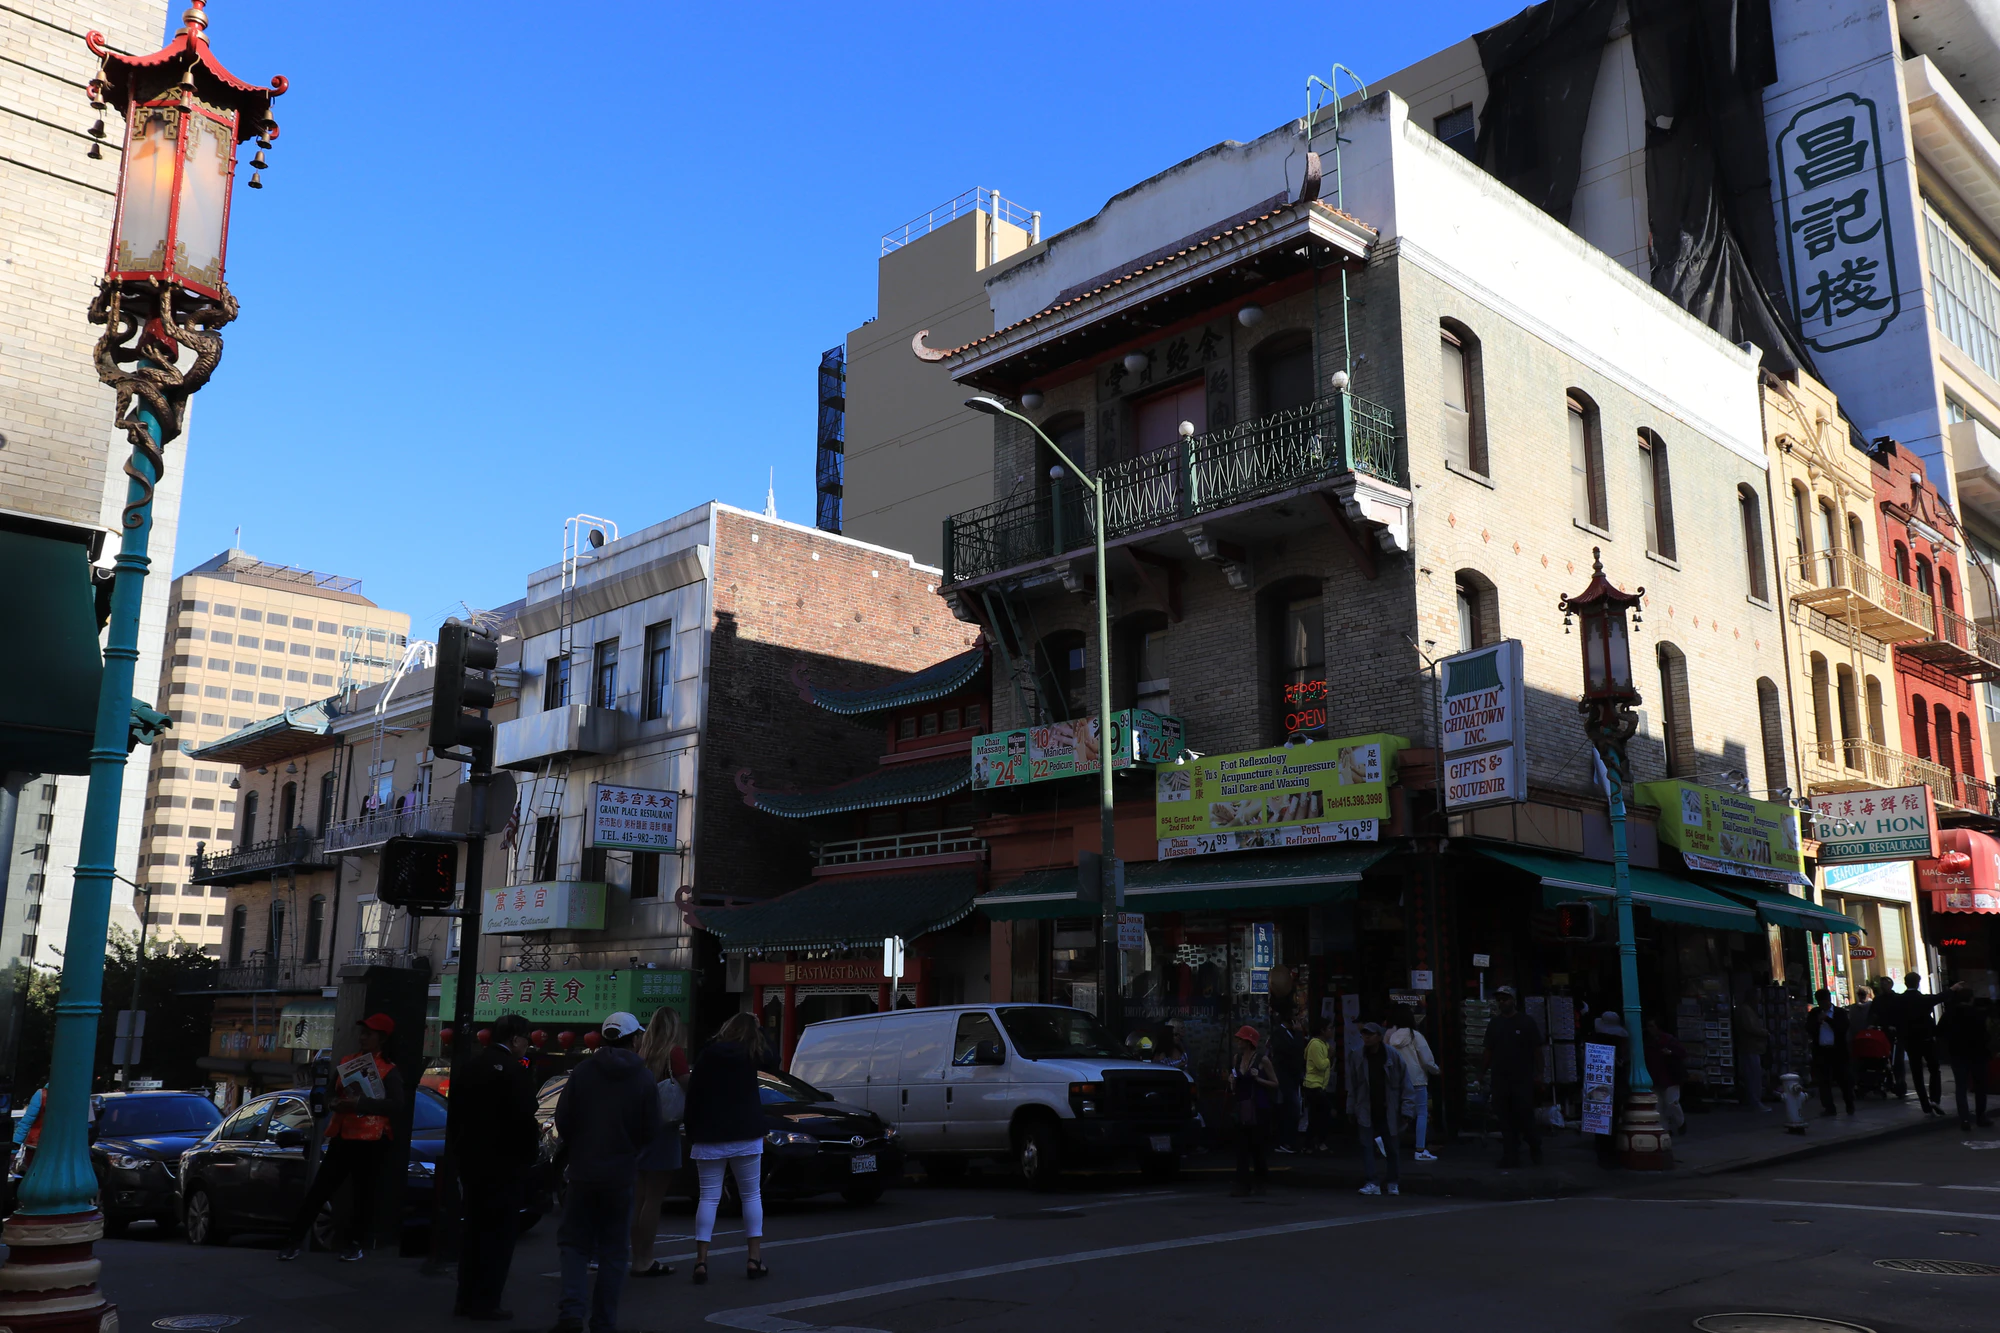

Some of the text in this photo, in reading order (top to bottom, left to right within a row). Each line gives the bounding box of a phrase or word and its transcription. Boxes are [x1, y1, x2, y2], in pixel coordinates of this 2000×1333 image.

[1449, 690, 1499, 716] ONLY IN
[1135, 719, 1160, 732] Massage
[1285, 707, 1327, 731] OPEN
[1444, 707, 1505, 734] CHINATOWN
[984, 737, 1000, 747] Chair
[1464, 729, 1487, 746] INC.
[977, 745, 1006, 755] Massage
[1043, 745, 1073, 757] Manicure
[1050, 760, 1073, 771] Pedicure
[1075, 762, 1091, 772] Foot
[1221, 754, 1287, 770] Foot Reflexology
[1450, 755, 1502, 779] GIFTS &
[1221, 769, 1272, 783] Acupuncture
[1282, 760, 1336, 776] Acupressure
[1221, 777, 1310, 795] Nail Care and Waxing
[1449, 777, 1505, 800] SOUVENIR
[600, 805, 673, 819] GRANT PLACE RESTAURANT
[1720, 796, 1755, 814] Foot Reflexology
[1174, 816, 1190, 824] Grant
[1722, 809, 1750, 822] Acupuncture
[1180, 823, 1195, 831] Floor
[1301, 825, 1320, 835] Foot
[1722, 821, 1768, 840] Nail Care and Waxing
[1820, 816, 1925, 838] BOW HON
[601, 830, 668, 845] TEL. 415-982-3705
[1171, 838, 1188, 848] Chair
[1694, 831, 1706, 841] Grant
[1164, 847, 1197, 857] Massage
[1823, 838, 1928, 857] SEAFOOD RESTAURANT
[1947, 877, 1972, 885] CAFE
[488, 916, 550, 931] Grant Place Restaurant
[473, 1007, 590, 1017] Grant Place Restaurant
[221, 1034, 251, 1049] SWEET
